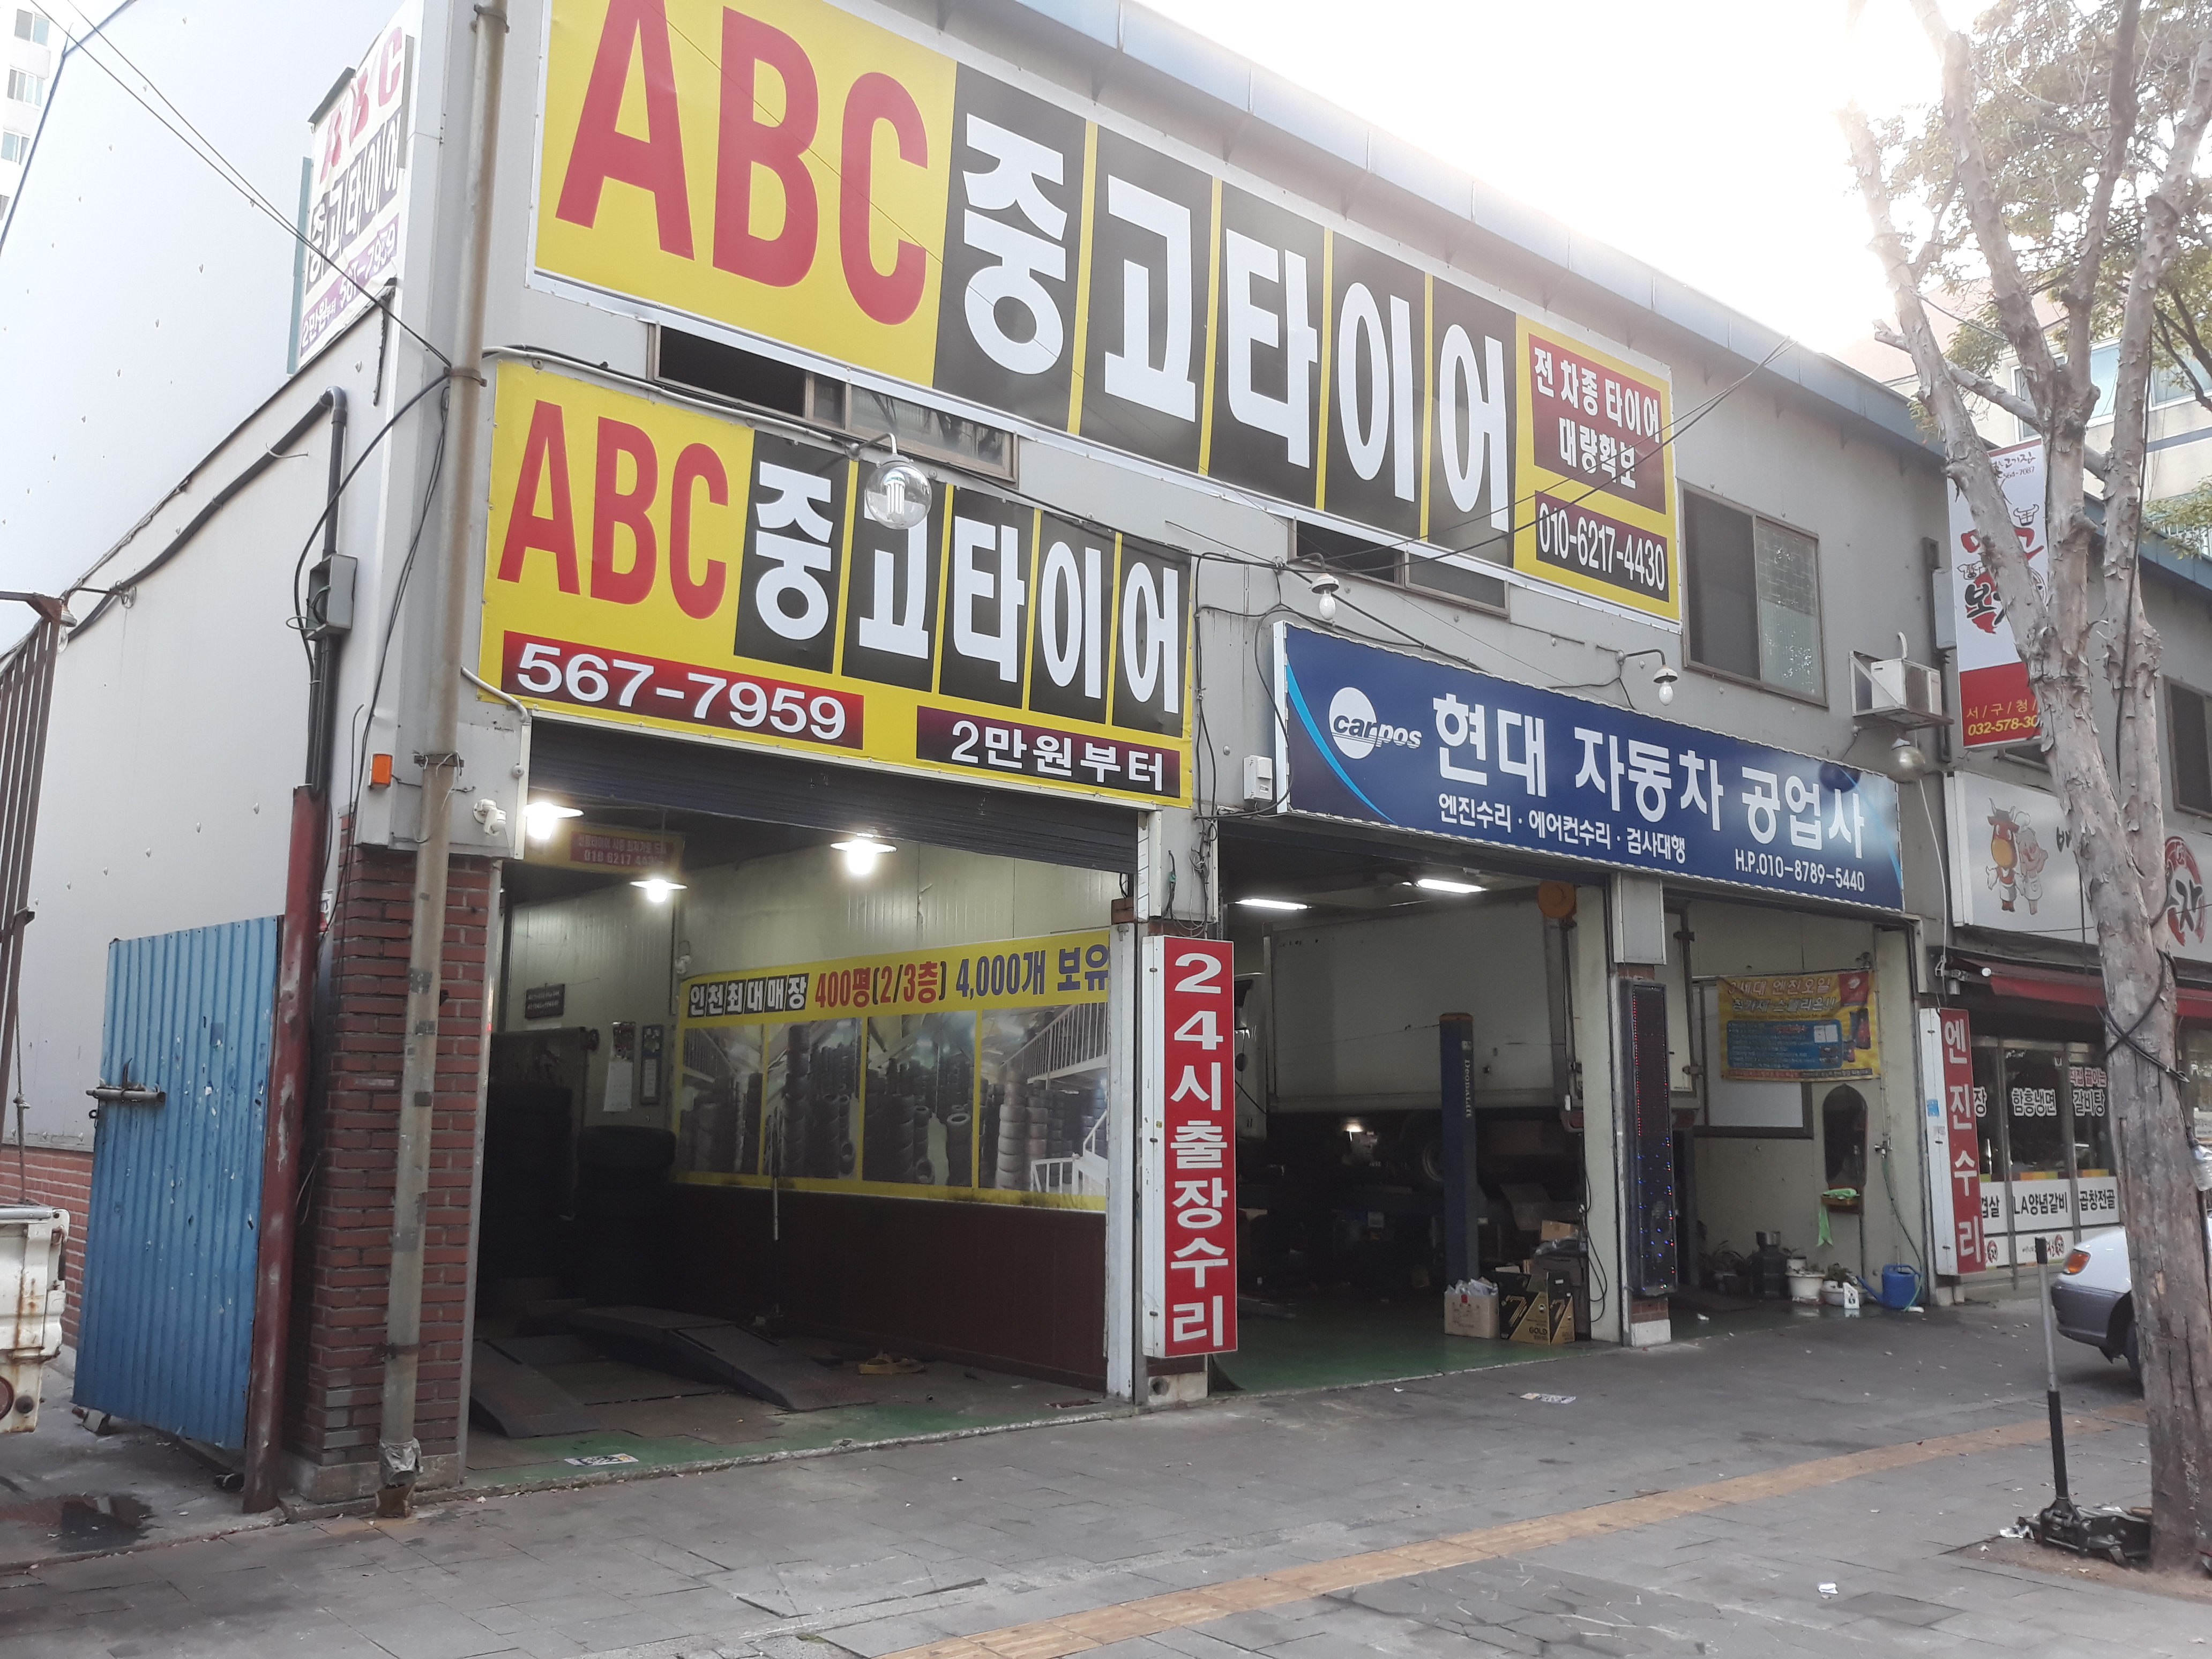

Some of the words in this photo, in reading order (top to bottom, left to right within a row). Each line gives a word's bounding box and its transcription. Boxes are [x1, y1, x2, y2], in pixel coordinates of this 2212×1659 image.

[556, 0, 928, 326] ABC
[962, 113, 1509, 533] 중고타이어
[1534, 346, 1555, 398] 전
[1560, 359, 1599, 416] 차종
[1605, 378, 1660, 444] 타이어
[1559, 417, 1636, 489] 대량확보
[497, 399, 729, 620] ABC
[1538, 502, 1665, 592] 010-6217-4430
[755, 461, 1179, 714] 중고타이어
[517, 642, 846, 740] 567-7959
[951, 720, 1163, 791] 2만원부터
[1432, 693, 1547, 798] 현대
[1574, 726, 1724, 832] 자동차
[1741, 765, 1865, 860] 공업사
[1438, 793, 1512, 833] 엔진수리
[1528, 810, 1610, 850] 에어컨수리
[1626, 827, 1686, 864] 검사대행
[689, 974, 808, 1018] 인천최대매장
[956, 950, 1047, 1002] 4,000개
[1057, 943, 1109, 992] 보유
[1944, 1019, 1982, 1264] 엔진수리
[2011, 1087, 2057, 1117] 함흥냉면
[2072, 1088, 2106, 1117] 갈비탕
[2079, 1189, 2116, 1212] 곱창전골
